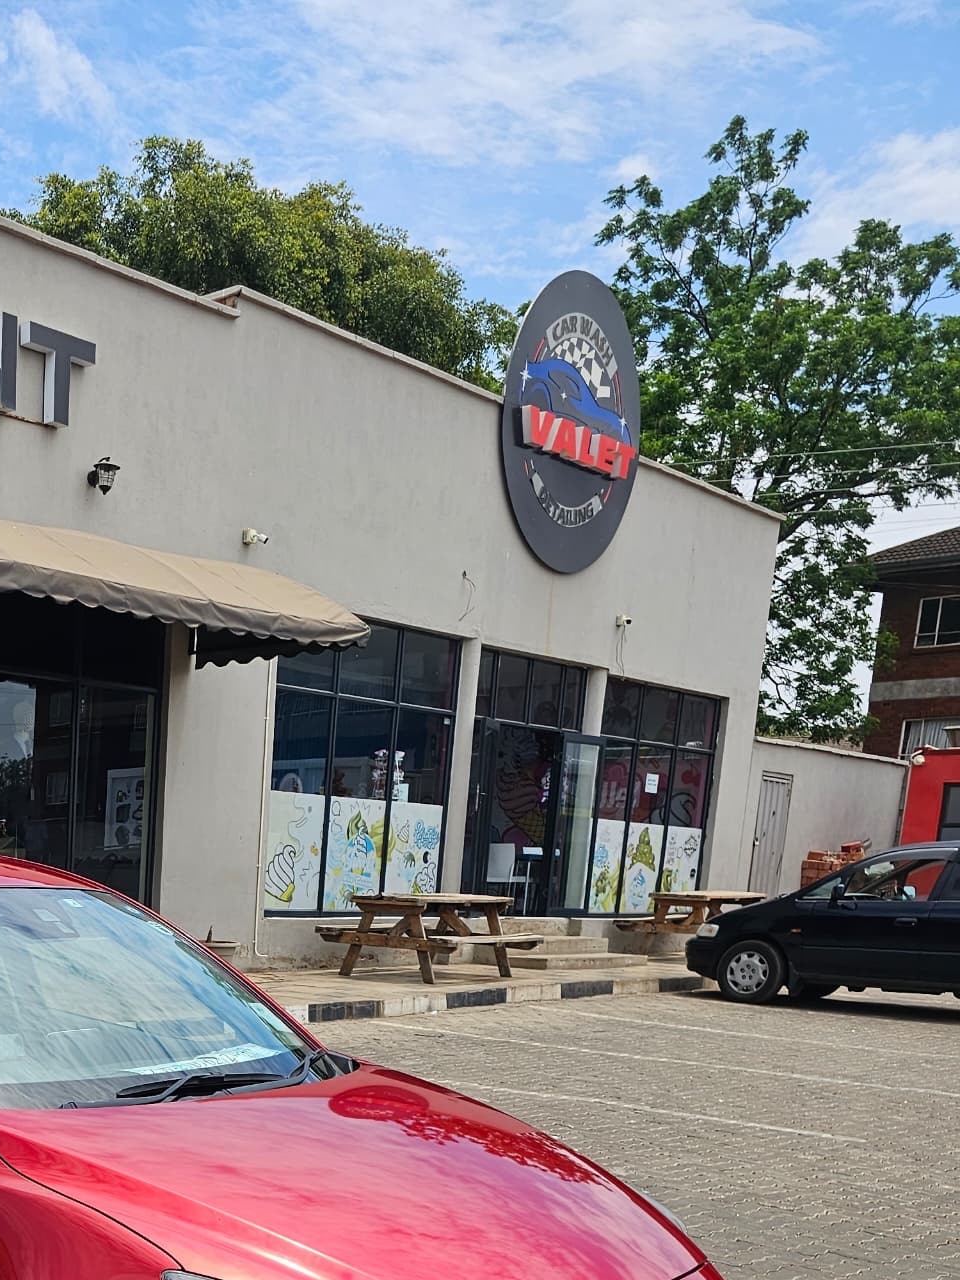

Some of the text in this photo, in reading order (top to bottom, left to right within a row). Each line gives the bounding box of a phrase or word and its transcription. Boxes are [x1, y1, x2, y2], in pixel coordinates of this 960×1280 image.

[552, 316, 613, 367] CAR WASH
[522, 404, 637, 480] VALET
[540, 486, 594, 526] DETAILING
